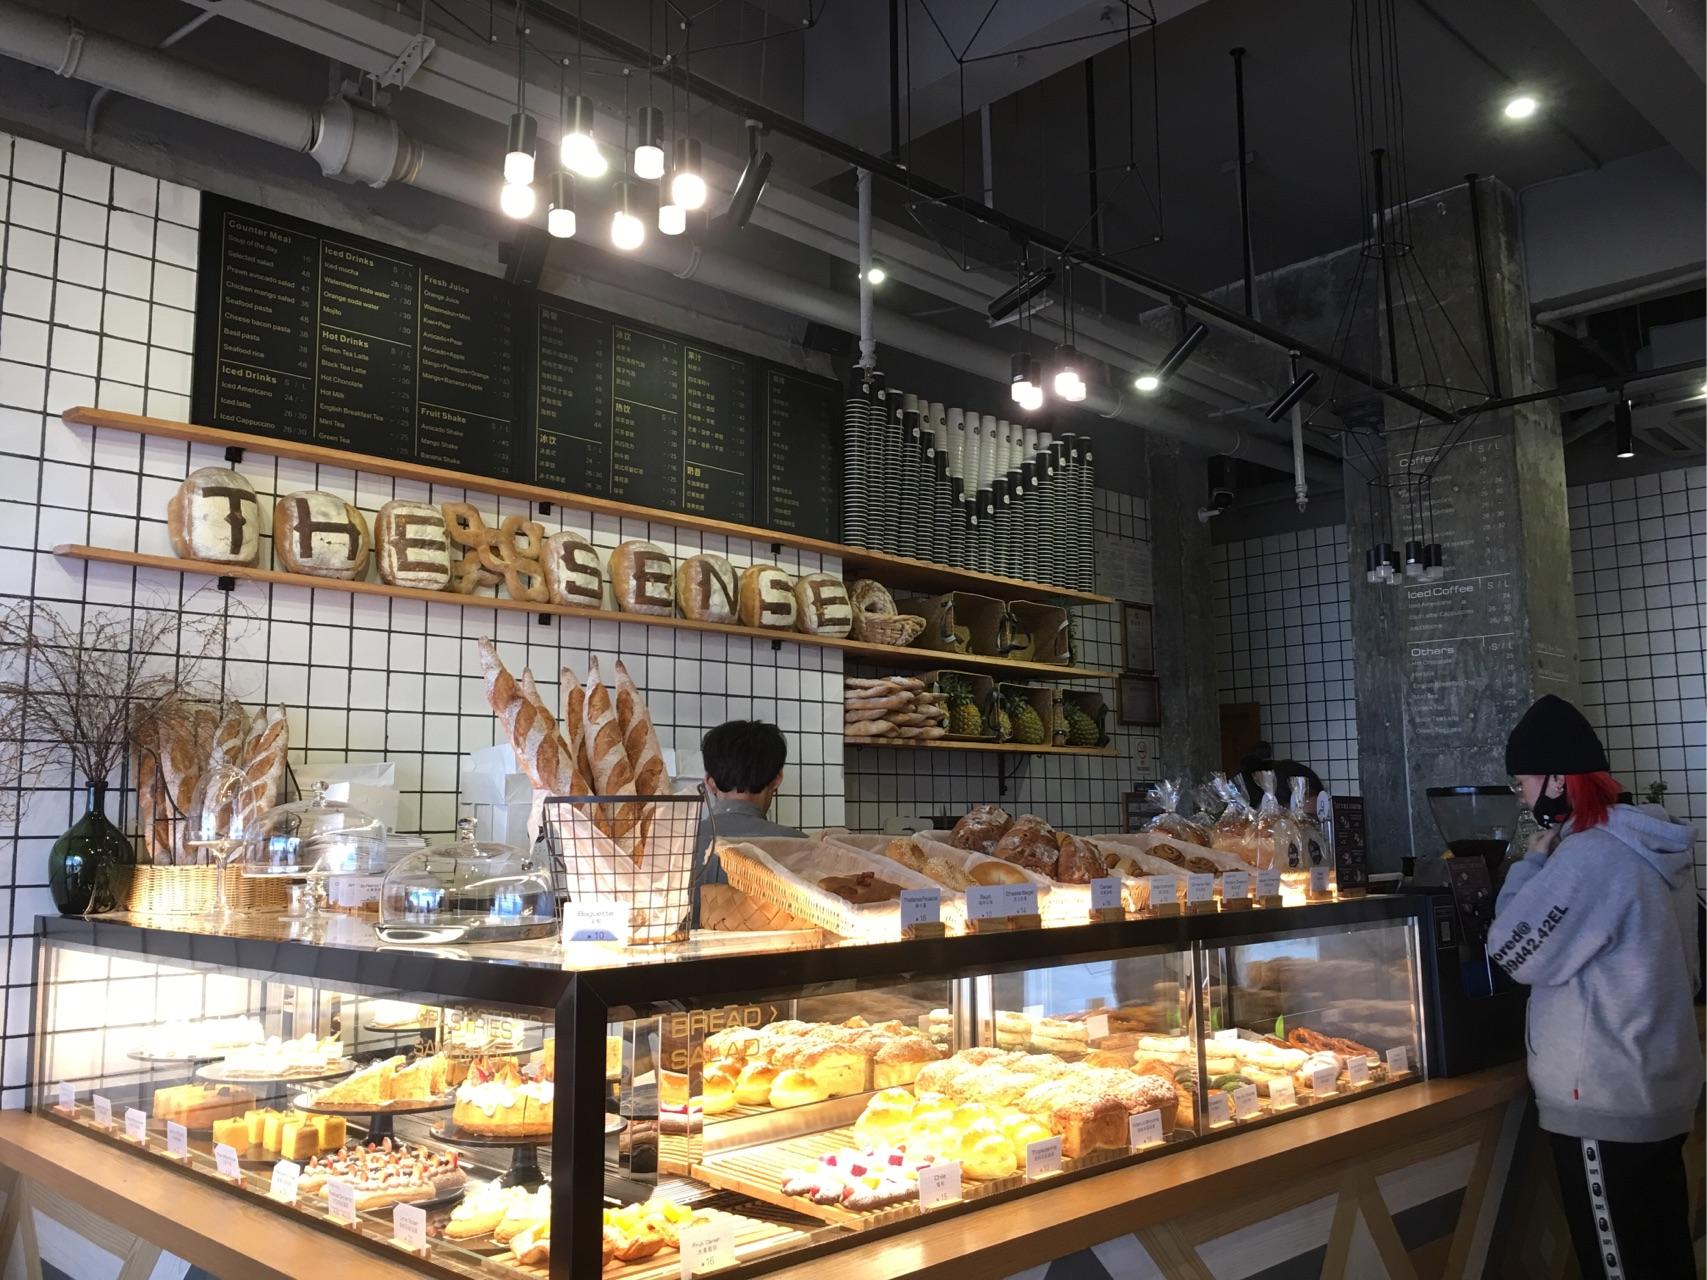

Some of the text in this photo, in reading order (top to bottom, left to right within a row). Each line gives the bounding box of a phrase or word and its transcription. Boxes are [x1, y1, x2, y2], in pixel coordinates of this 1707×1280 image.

[228, 220, 292, 244] Counter Meal
[228, 250, 274, 268] Selected salad
[325, 246, 374, 267] Iced Drinks
[226, 265, 248, 276] Prawn
[278, 279, 296, 289] salad
[324, 262, 359, 276] Iced mocha
[226, 280, 253, 292] Chicken
[277, 294, 296, 304] salad
[324, 276, 390, 299] Watermelon soda water
[424, 274, 470, 294] Fresh Juice
[324, 290, 379, 310] Orange soda water
[423, 289, 445, 301] Orange
[225, 296, 272, 314] Seafood pasta
[224, 312, 292, 334] Cheese bacon pasta
[224, 328, 260, 342] Basil pasta
[322, 330, 369, 348] Hot Drinks
[224, 343, 251, 355] Seafood
[321, 345, 369, 361] Green Tea Latte
[222, 365, 278, 384] Iced Drinks
[321, 359, 367, 375] Black Tea Latte
[320, 374, 333, 382] Hot
[222, 381, 273, 397] Iced Americano
[320, 388, 345, 399] Hot Milk
[220, 397, 236, 406] Iced
[615, 402, 631, 415] 热饮
[319, 402, 343, 413] English
[373, 413, 384, 422] Tea
[421, 408, 467, 424] Fruit Shake
[220, 412, 276, 429] Iced Cappuccino
[319, 417, 345, 428] Mint Tea
[318, 432, 351, 444] Green Tea
[420, 423, 464, 437] Avocado Shake
[420, 437, 459, 450] Mango Shake
[540, 433, 557, 446] 冰饮
[420, 452, 461, 465] Banana Shake
[560, 540, 852, 628] SENSE
[1408, 589, 1432, 600] Iced
[1433, 585, 1474, 596] Coffee
[1411, 647, 1455, 657] Others
[577, 910, 614, 918] Baguette
[1493, 921, 1532, 962] ored@
[671, 1006, 762, 1038] BREAD
[671, 1038, 760, 1070] SALAD
